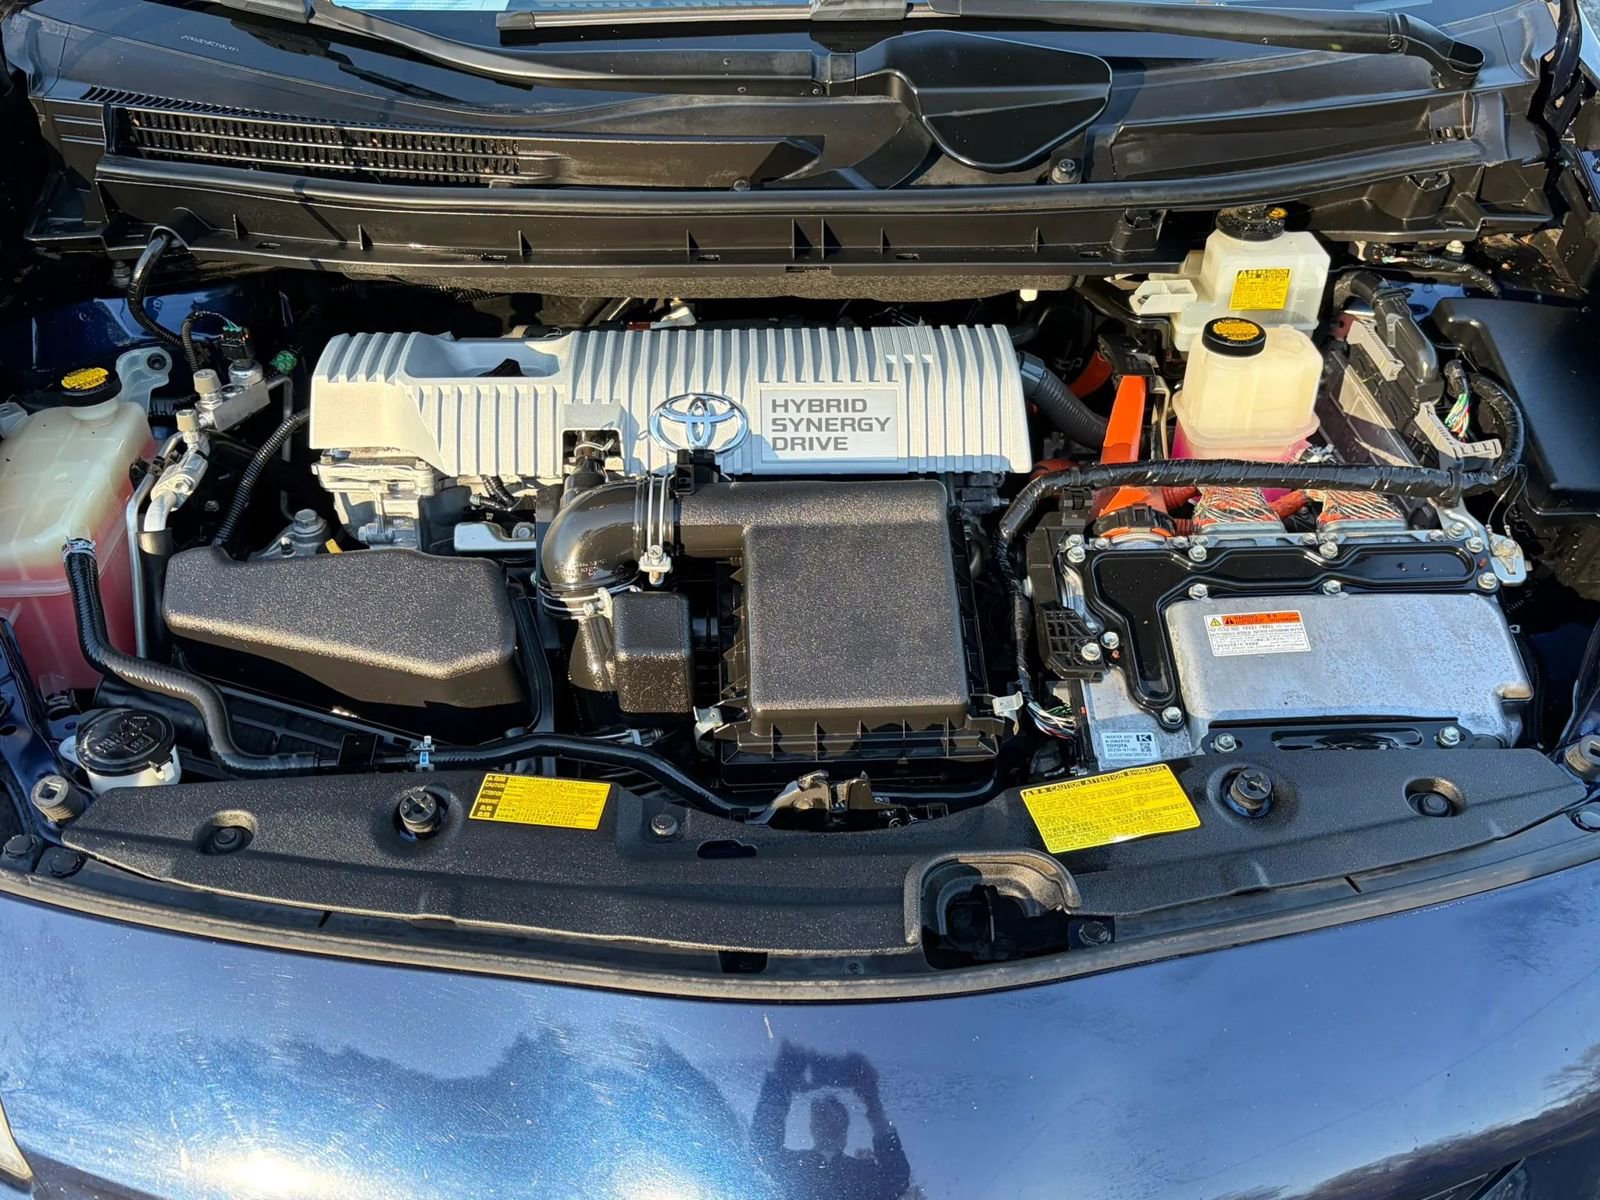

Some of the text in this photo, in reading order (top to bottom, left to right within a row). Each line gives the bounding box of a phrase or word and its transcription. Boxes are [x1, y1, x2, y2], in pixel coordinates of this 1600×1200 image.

[771, 398, 868, 413] HYBRID
[771, 417, 892, 432] SYNERGY
[771, 436, 848, 451] DRIVE
[1050, 782, 1081, 793] CAUTION
[1085, 773, 1124, 785] ATTENTION
